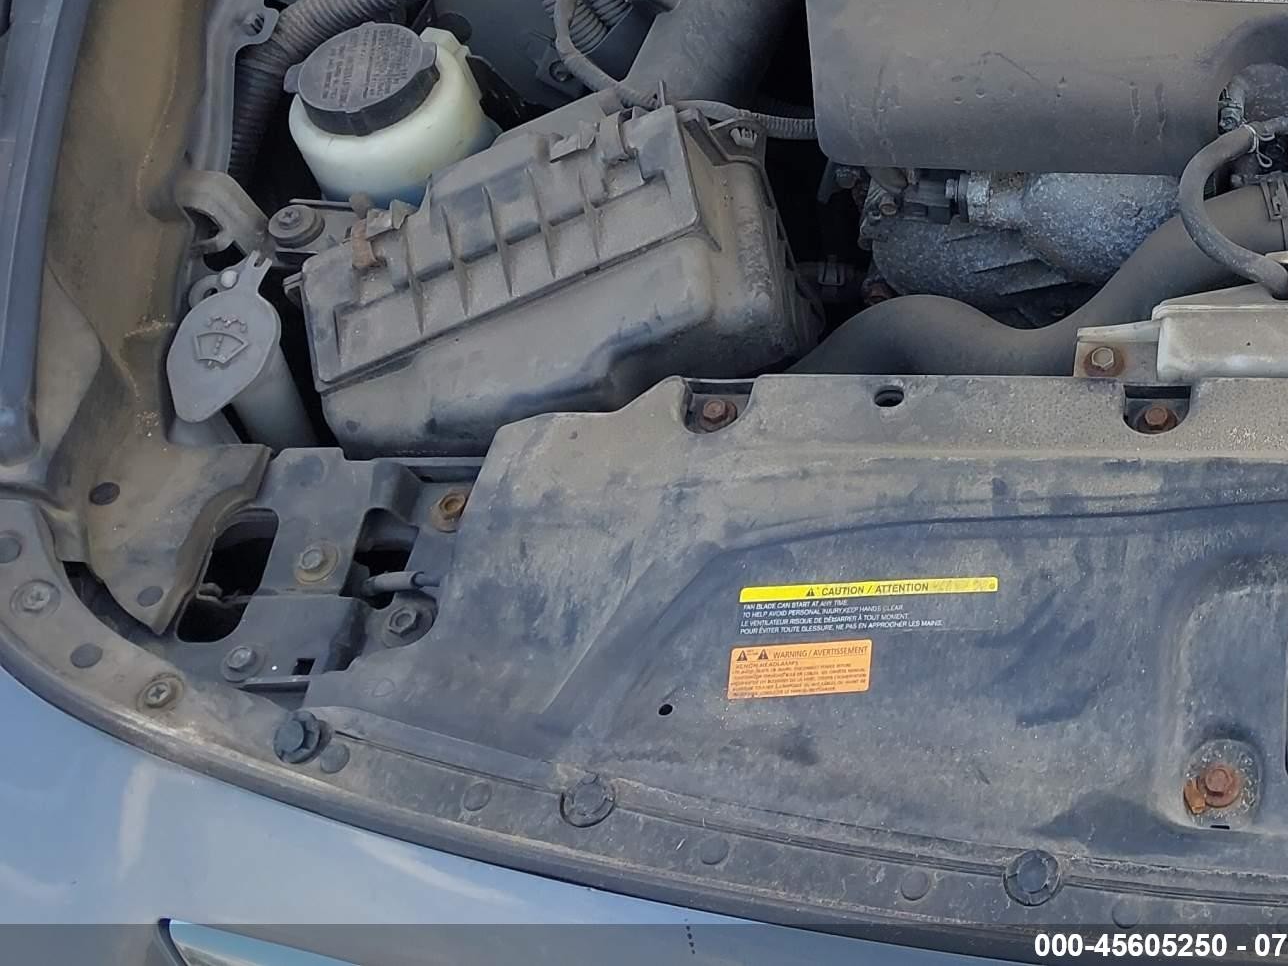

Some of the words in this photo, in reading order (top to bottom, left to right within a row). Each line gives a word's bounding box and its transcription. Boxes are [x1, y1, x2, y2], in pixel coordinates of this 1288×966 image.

[821, 585, 864, 597] CAUTION
[875, 582, 929, 594] ATTENTION
[756, 602, 776, 610] BLADE
[777, 601, 791, 609] CAN
[791, 601, 811, 609] START
[773, 650, 808, 660] WARNING
[813, 646, 869, 657] AVERTISSEMENT
